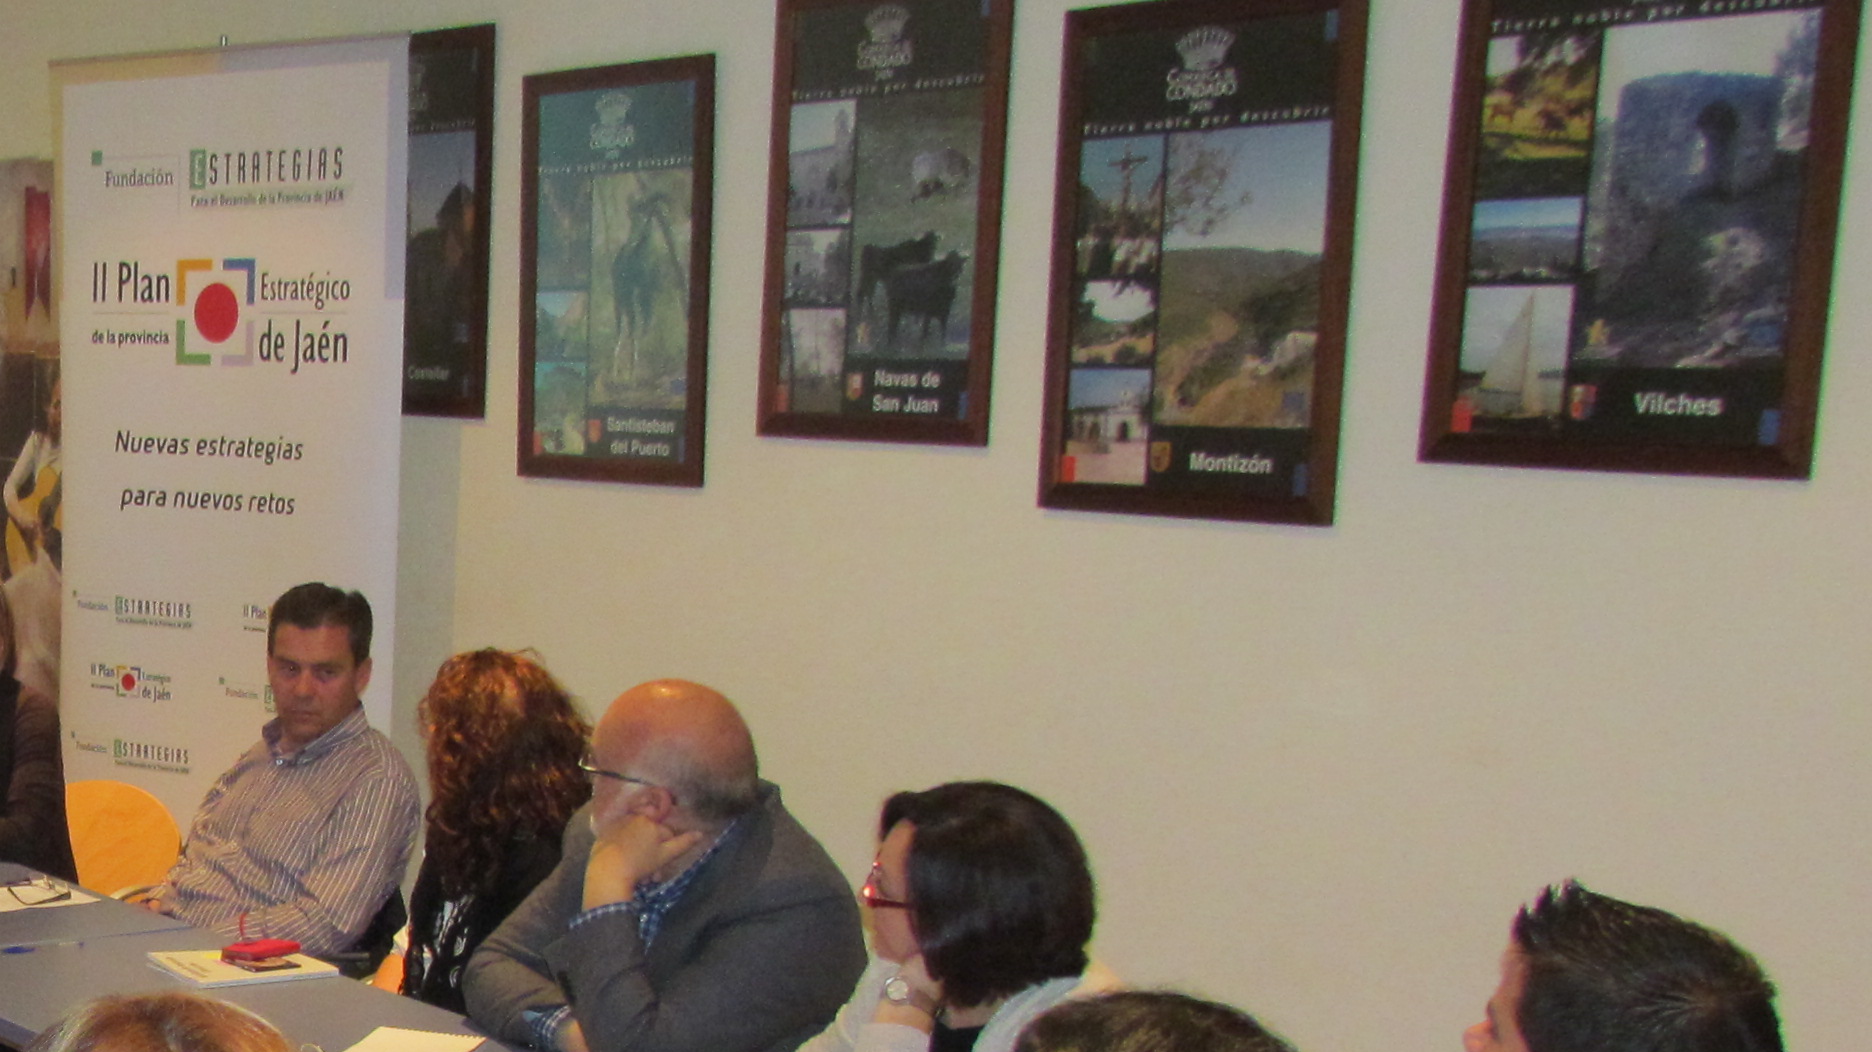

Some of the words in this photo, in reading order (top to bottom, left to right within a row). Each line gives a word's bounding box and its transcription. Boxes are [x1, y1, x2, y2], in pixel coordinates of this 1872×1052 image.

[1491, 19, 1560, 34] Tierra
[1647, 5, 1685, 22] por
[884, 82, 906, 94] por
[1166, 81, 1237, 101] CONDADO
[1200, 114, 1230, 129] por
[1240, 106, 1328, 123] descubrir
[105, 168, 174, 188] Fundación
[189, 147, 343, 189] ESTRATEGIAS
[93, 261, 107, 303] II
[118, 260, 170, 303] Plan
[260, 271, 350, 310] Estratégico
[91, 329, 104, 344] de
[107, 329, 116, 344] la
[118, 329, 170, 348] provincia
[259, 319, 285, 363] de
[289, 319, 348, 375] Jaén
[874, 369, 919, 388] Navas
[921, 370, 941, 388] de
[872, 394, 900, 412] San
[903, 395, 939, 412] Juan
[1633, 391, 1724, 416] Vilches
[607, 416, 675, 434] Santisteban
[114, 430, 190, 455] Nuevas
[196, 435, 304, 466] estrategias
[610, 440, 628, 454] del
[631, 439, 670, 456] Puerto
[1189, 451, 1273, 474] Montizón
[120, 488, 167, 512] para
[173, 490, 243, 512] nuevos
[248, 493, 295, 515] retos
[115, 596, 192, 619] ESTRATEGIAS
[99, 663, 115, 677] Plan
[142, 686, 152, 700] de
[153, 686, 171, 703] Jaén
